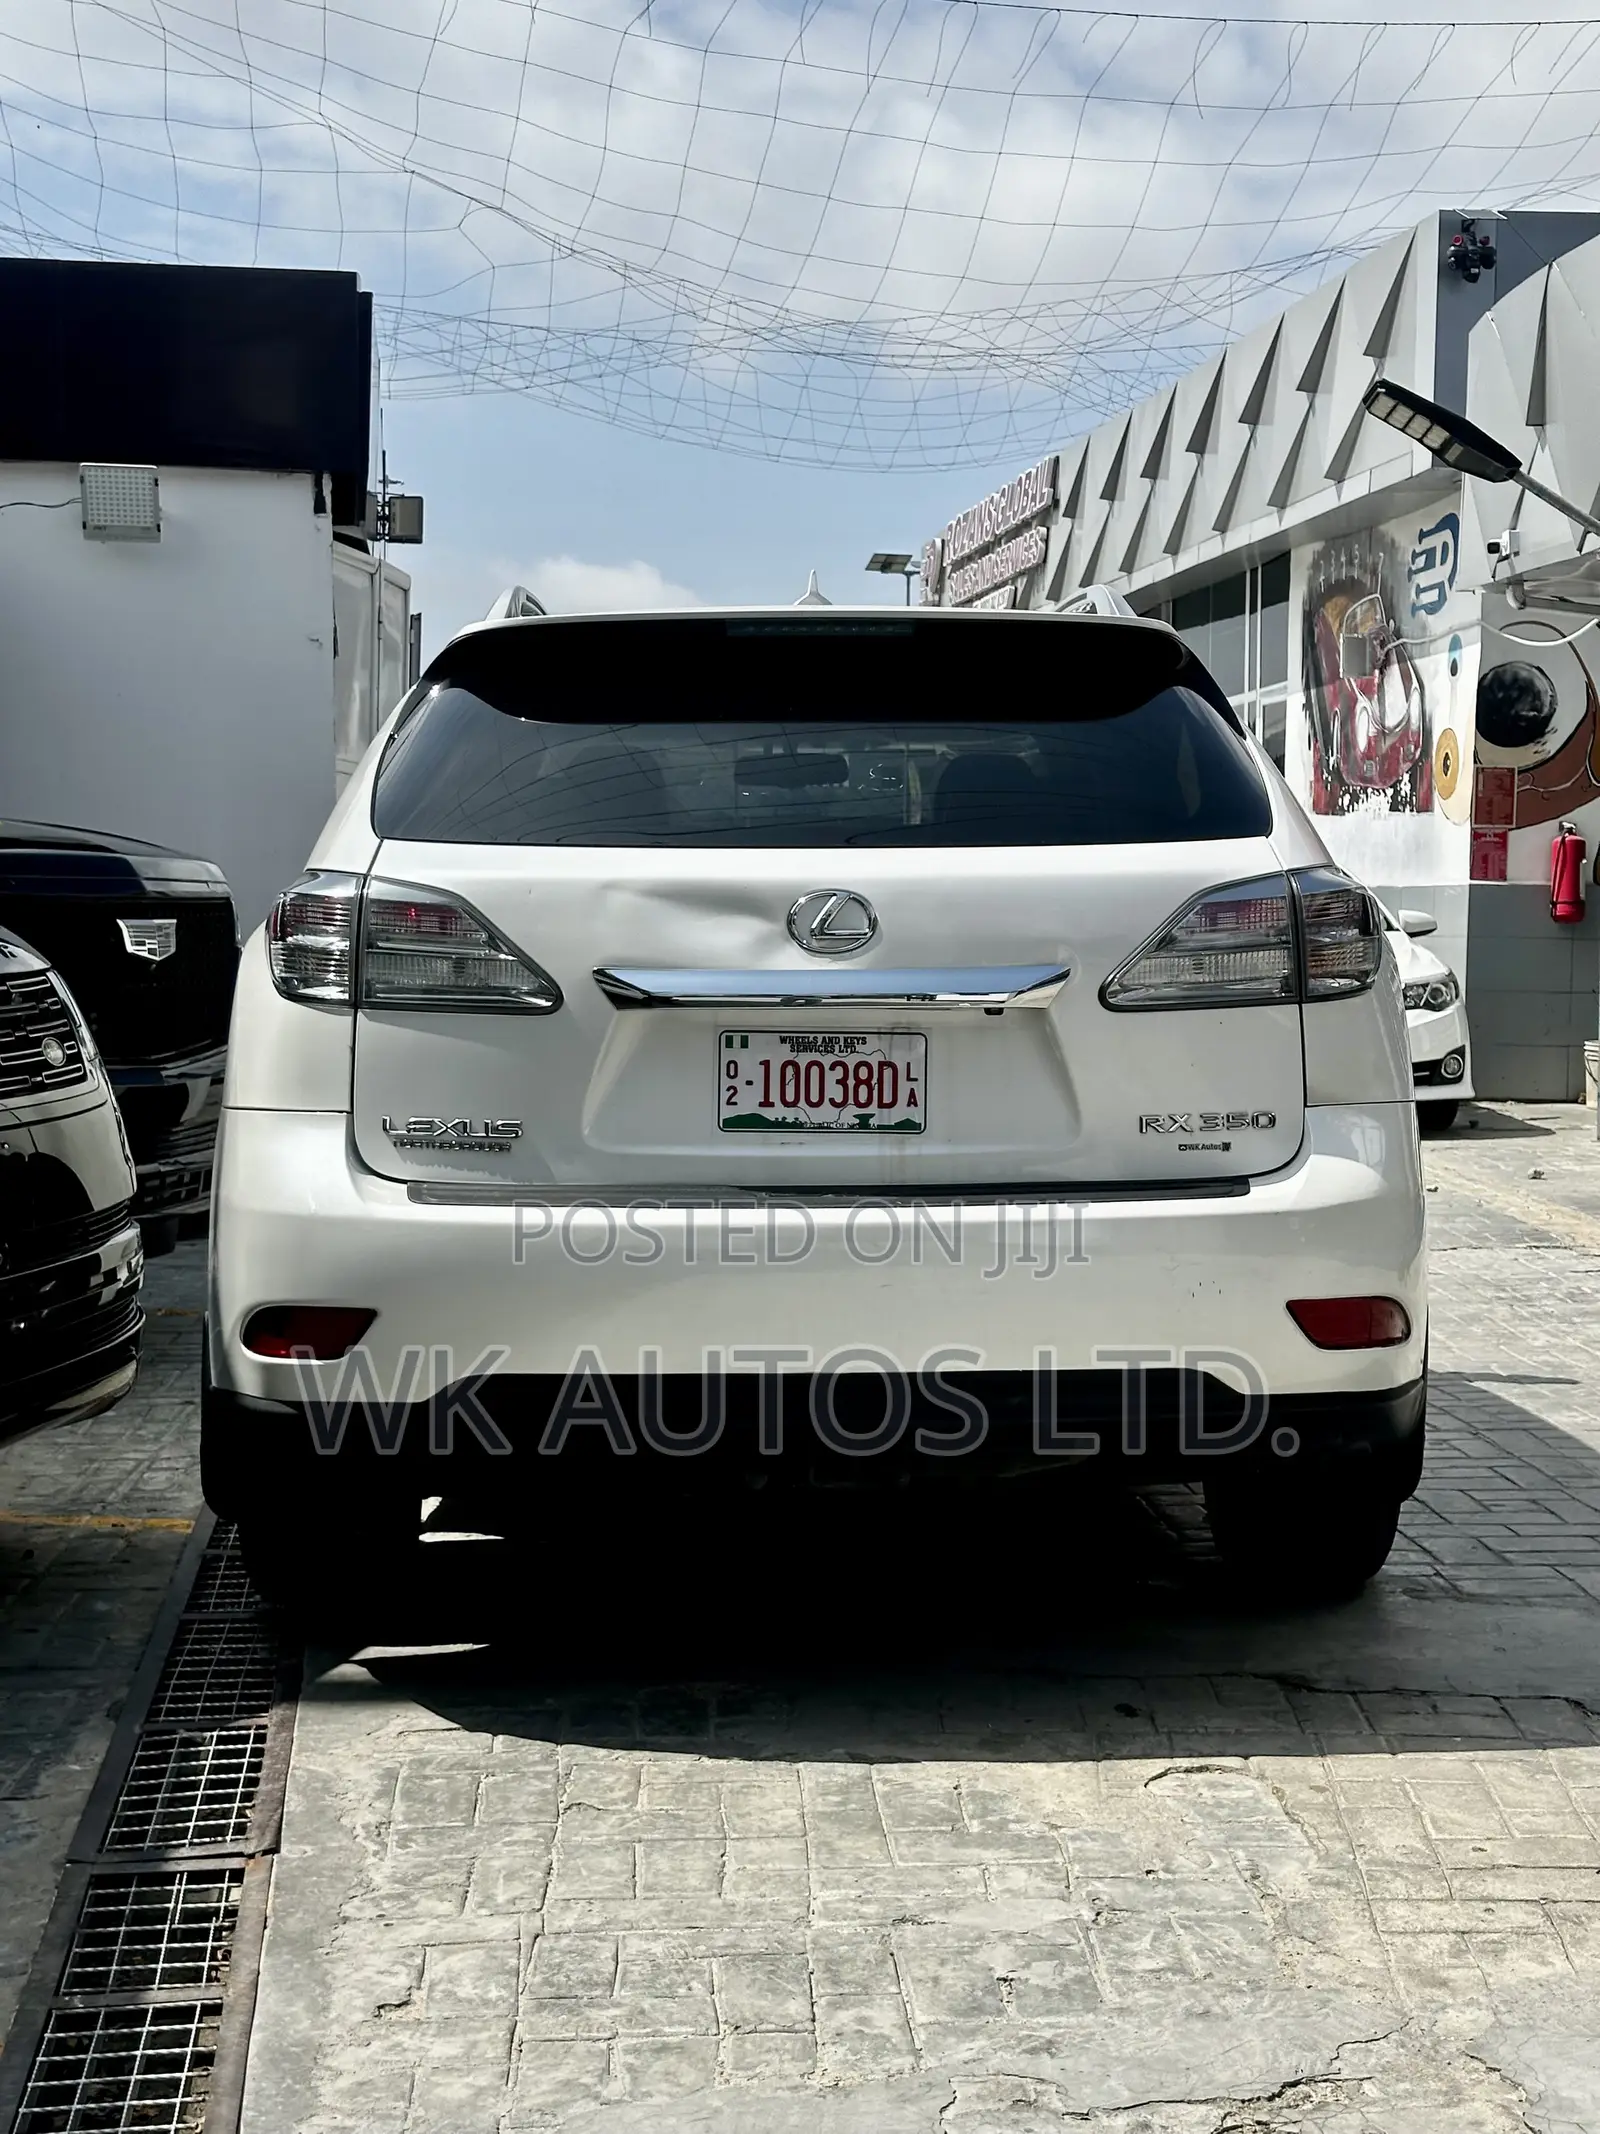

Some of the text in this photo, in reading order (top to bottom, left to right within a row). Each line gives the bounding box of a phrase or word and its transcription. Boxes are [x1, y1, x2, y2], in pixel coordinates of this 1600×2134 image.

[994, 530, 1042, 582] SERVICES
[779, 1036, 867, 1046] WHEELS AND KEYS
[790, 1044, 836, 1054] SERVICES
[382, 1115, 523, 1138] LEXUS
[1139, 1111, 1276, 1134] RX 350
